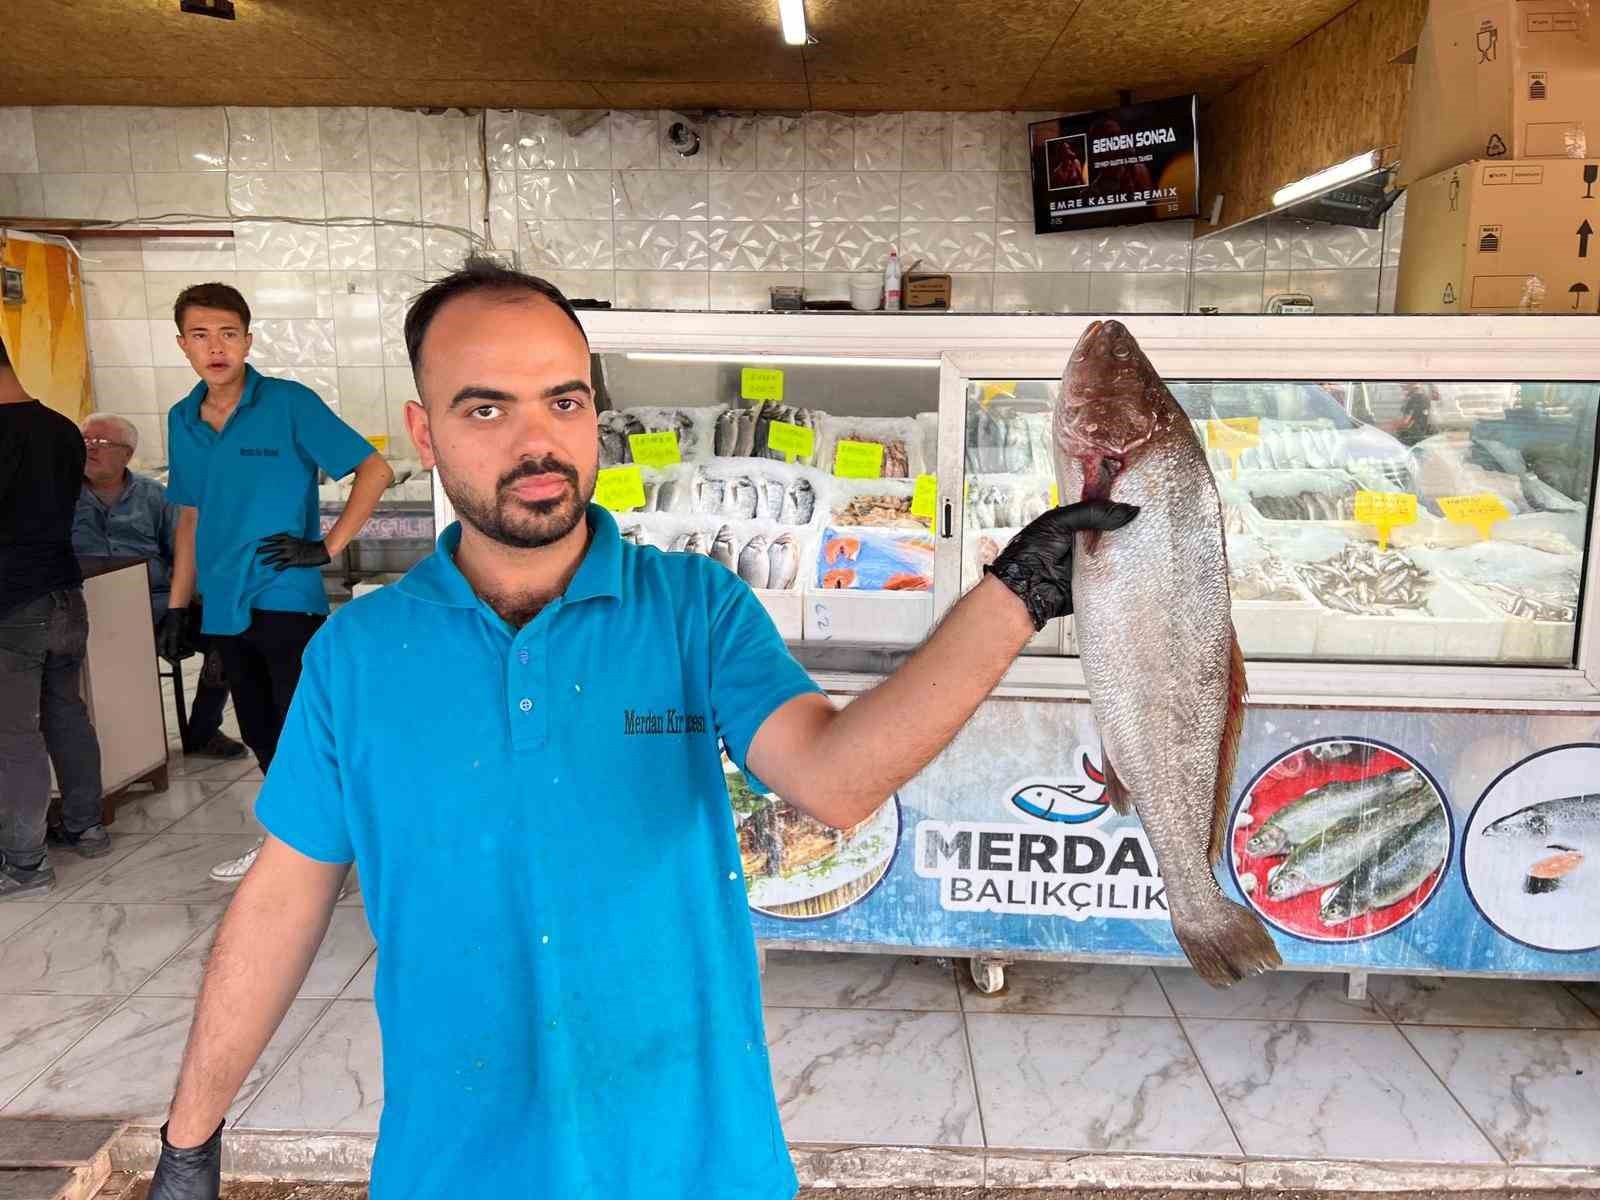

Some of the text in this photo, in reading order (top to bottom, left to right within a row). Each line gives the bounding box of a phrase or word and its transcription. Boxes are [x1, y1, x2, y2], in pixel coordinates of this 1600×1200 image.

[1092, 128, 1176, 153] BENDEN SONRA
[1049, 187, 1177, 211] EMRE KASIK REMIX
[624, 710, 664, 735] Merdan
[924, 829, 1160, 878] MERDA
[950, 877, 1168, 913] BALIKÇILIK
